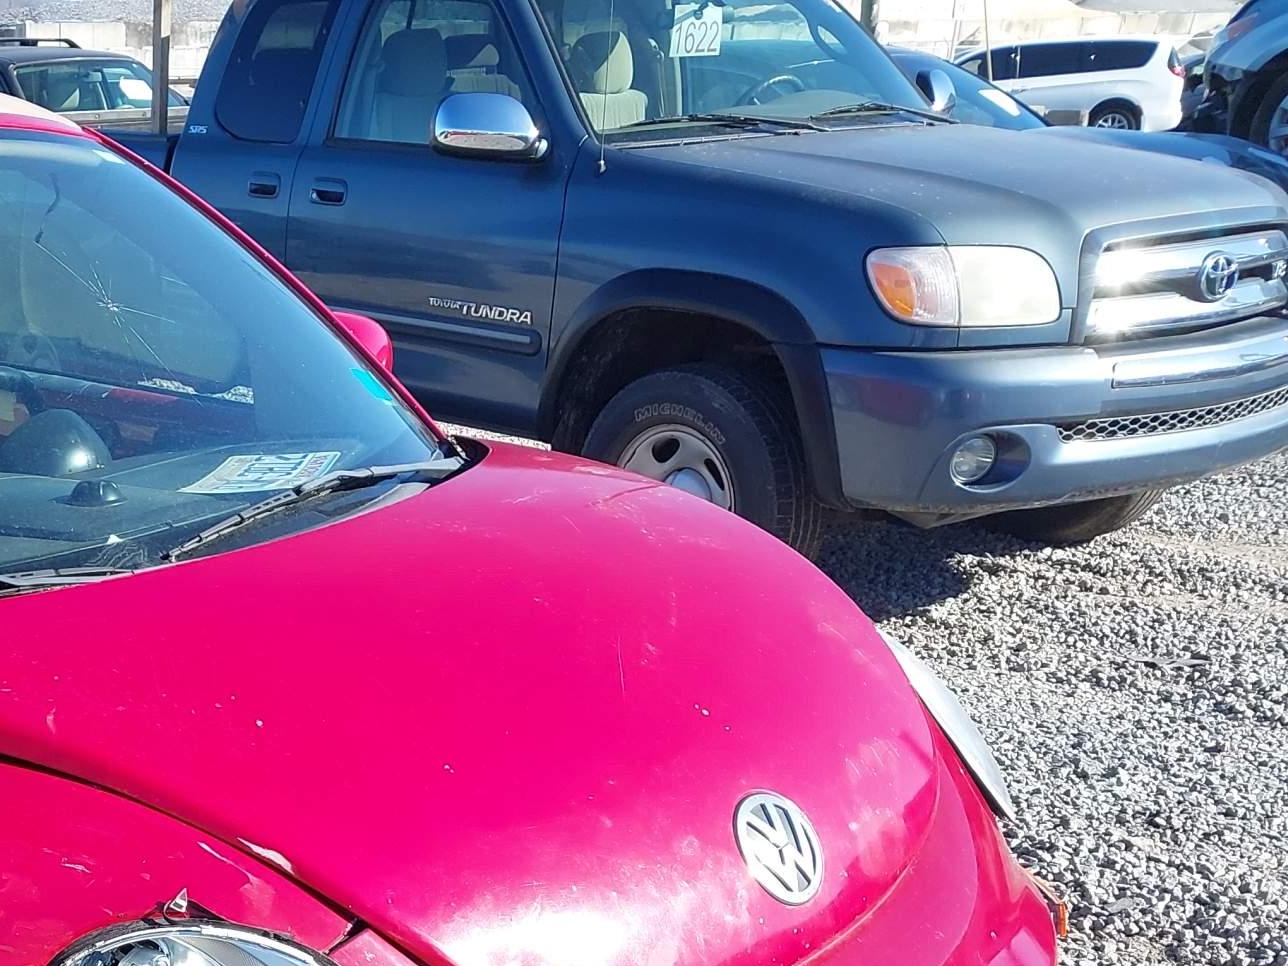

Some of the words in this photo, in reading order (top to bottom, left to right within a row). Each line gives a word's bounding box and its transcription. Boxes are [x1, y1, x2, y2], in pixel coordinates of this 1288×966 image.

[675, 21, 720, 54] 1622
[461, 302, 533, 325] TUNDRA
[634, 402, 727, 446] MICHELIN
